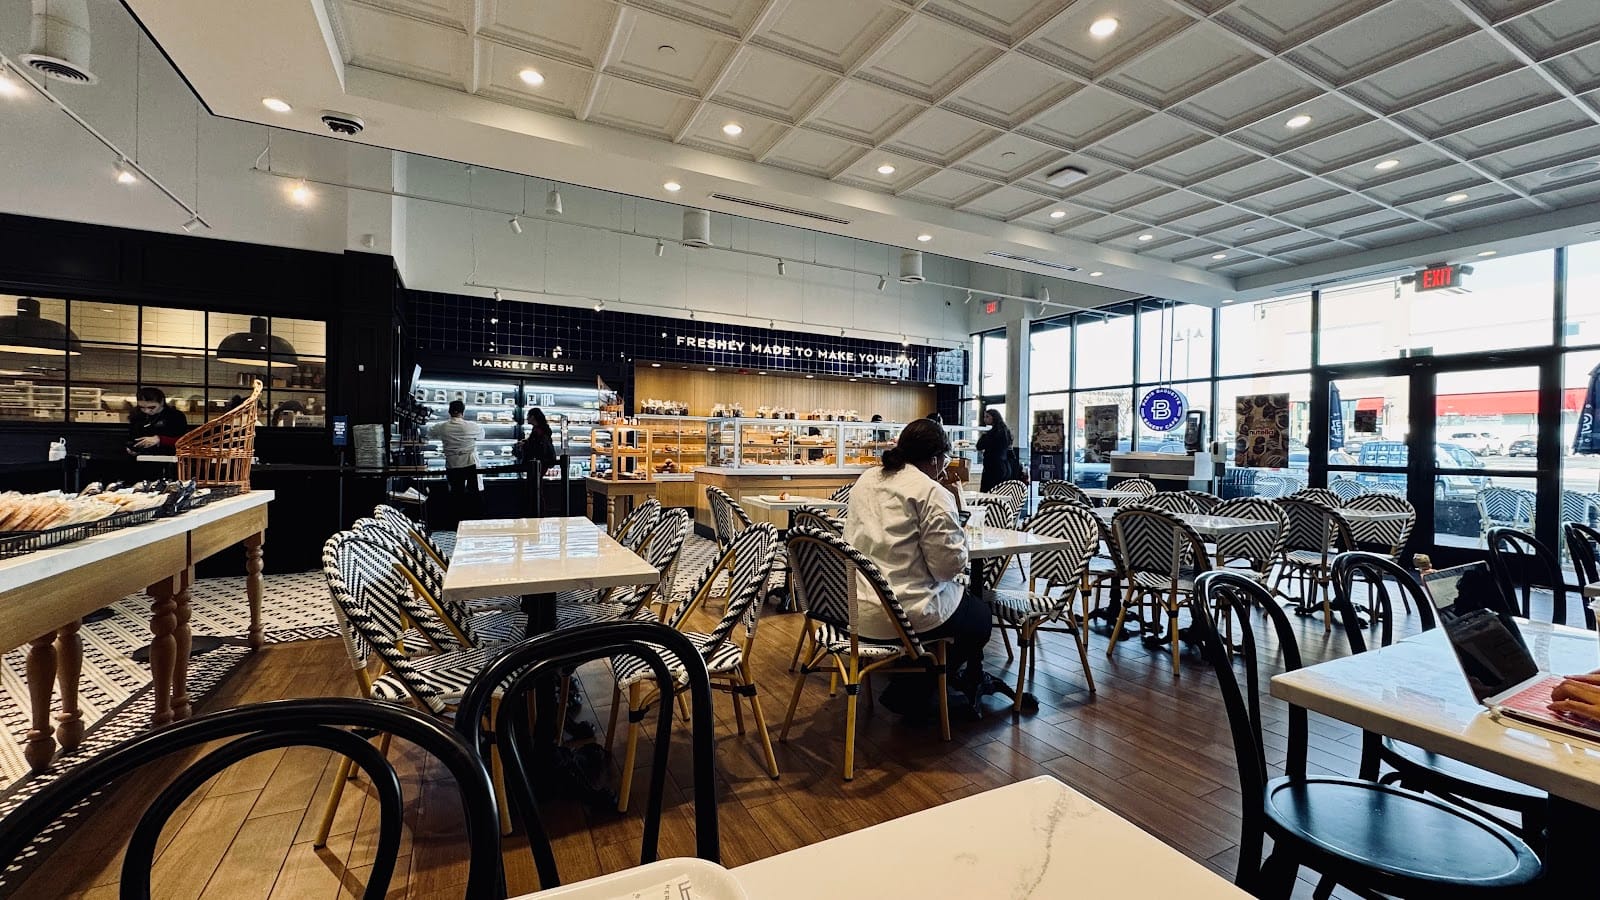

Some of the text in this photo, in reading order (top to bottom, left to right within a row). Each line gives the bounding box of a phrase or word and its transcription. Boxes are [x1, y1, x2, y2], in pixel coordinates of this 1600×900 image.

[1423, 266, 1452, 288] EXIT
[676, 335, 746, 352] FRESHLY
[750, 342, 792, 356] MADE
[797, 347, 813, 358] TO
[817, 350, 855, 362] MAKE
[859, 353, 892, 366] YOUR
[472, 358, 574, 373] MARKET FRESH
[1151, 399, 1172, 420] B
[1249, 427, 1274, 436] nutella
